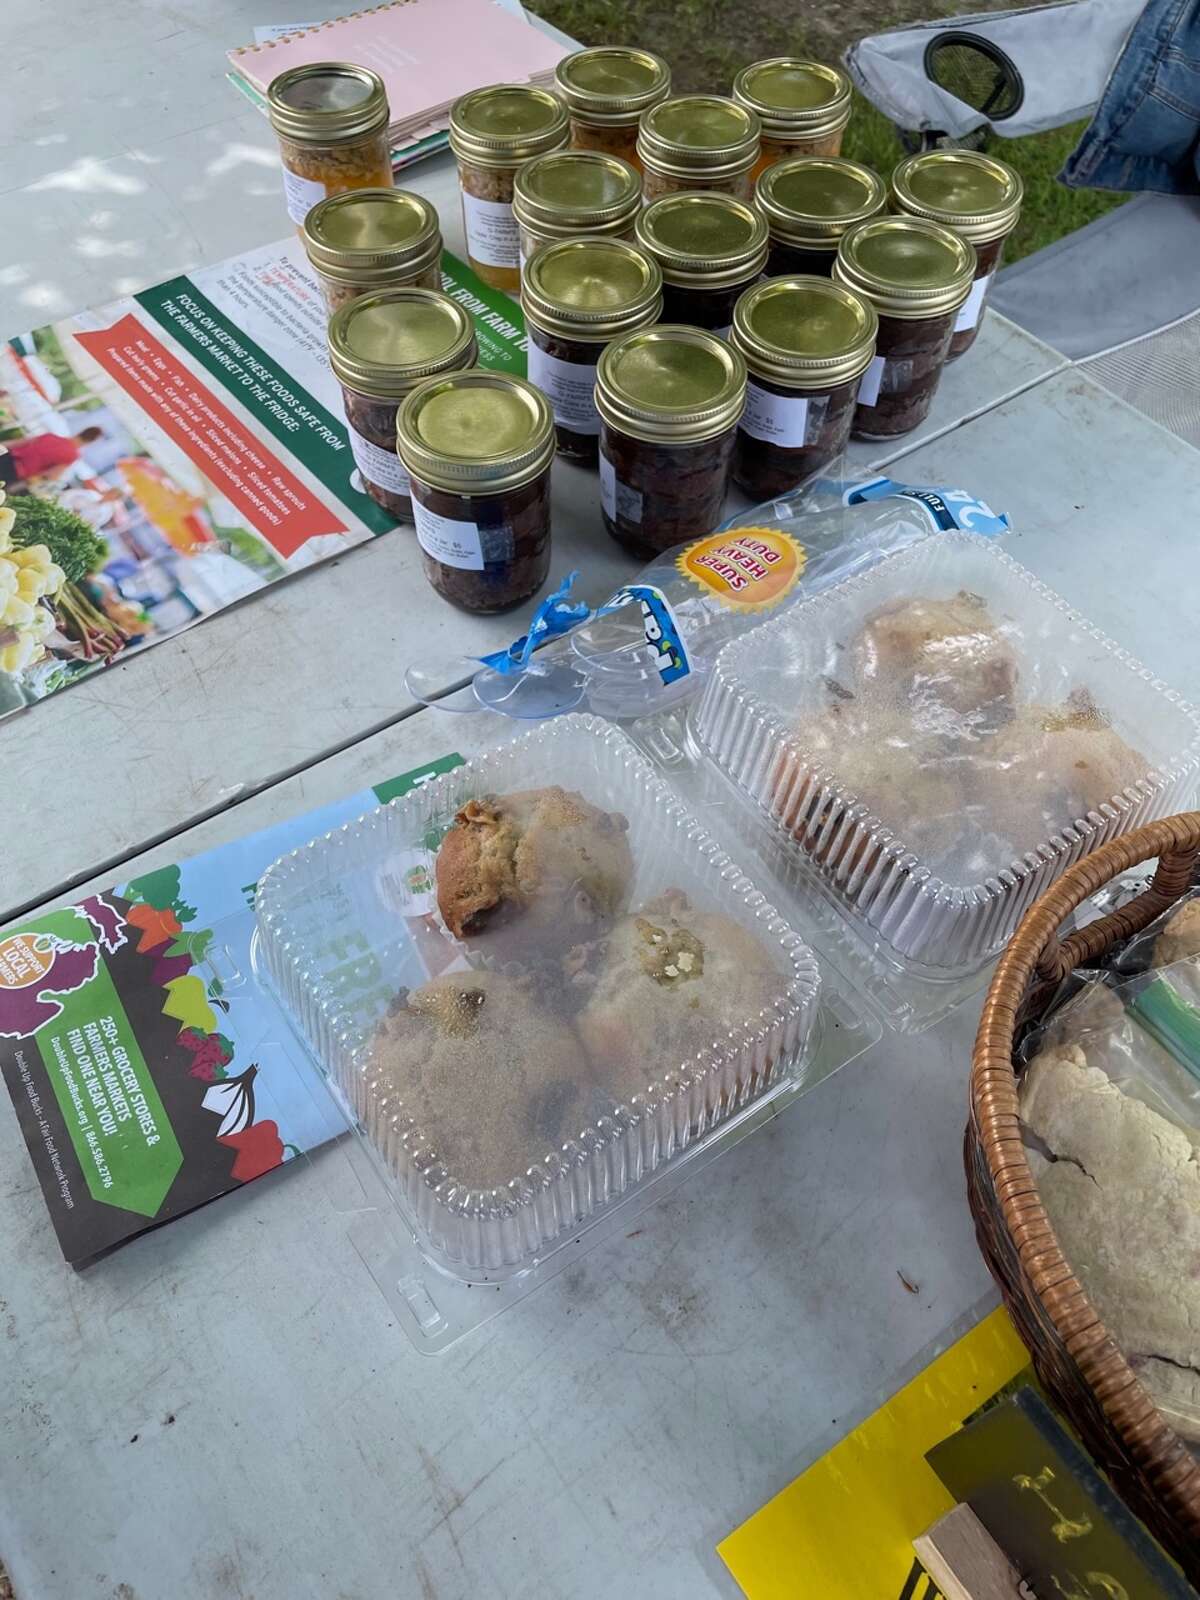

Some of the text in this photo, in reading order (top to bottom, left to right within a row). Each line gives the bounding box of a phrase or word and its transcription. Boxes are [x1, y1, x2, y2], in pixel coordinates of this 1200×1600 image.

[450, 288, 490, 315] FROM
[482, 312, 521, 340] FARM
[161, 300, 299, 430] THE FARMERS MARKET TO THE FRIDGE:
[177, 294, 345, 450] FOCUS ON KEEPING THESE FOODS SAFE FROM
[201, 406, 225, 428] products
[223, 428, 248, 451] including
[272, 477, 286, 489] Raw
[206, 430, 225, 446] Sliced
[248, 472, 267, 489] Sliced
[264, 489, 290, 514] tomatoes
[710, 544, 768, 580] HEAVY
[731, 538, 782, 564] DUTY
[695, 555, 748, 591] SUPER
[3, 947, 31, 978] LOCAL
[14, 1050, 28, 1072] Double
[21, 1072, 31, 1082] Up
[83, 1022, 132, 1121] FARMERS MARKETS
[26, 1081, 37, 1098] Food
[67, 1028, 117, 1136] FIND ONE NEAR YOU!
[100, 1016, 160, 1146] 250+ GROCERY STORES &
[30, 1096, 42, 1116] Bucks
[51, 1037, 88, 1124] DoubleUpFoodBucks.org
[86, 1131, 113, 1188] 866.586.2796
[41, 1124, 50, 1137] Fair
[44, 1136, 57, 1154] Food
[51, 1152, 66, 1180] Network
[60, 1179, 74, 1208] Program
